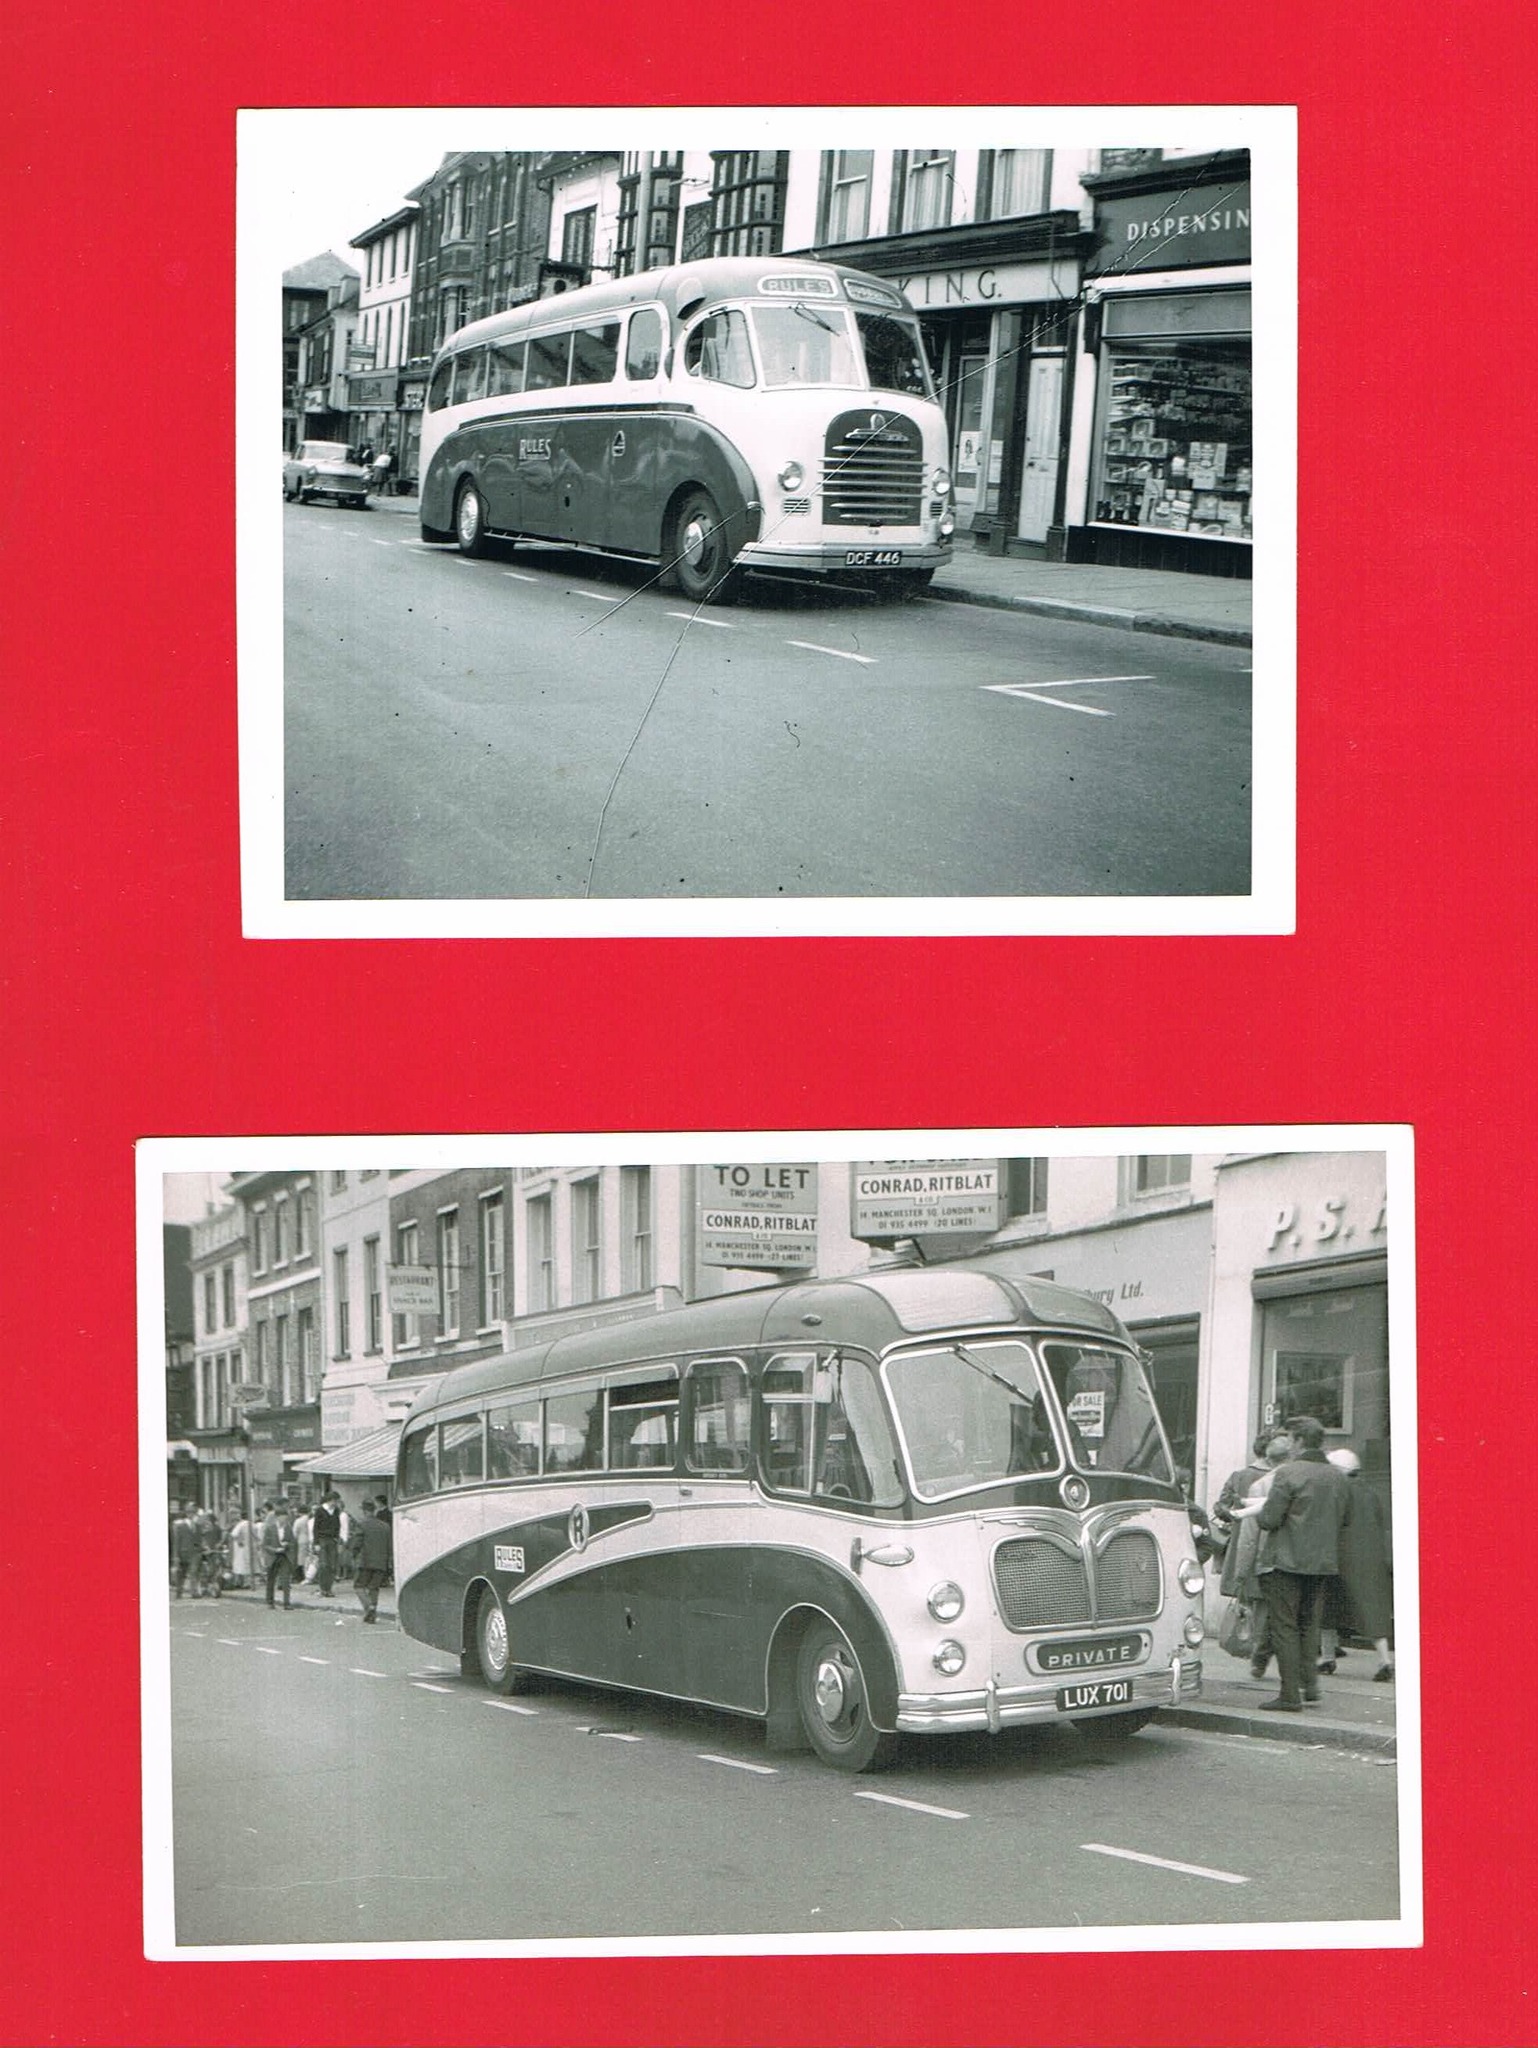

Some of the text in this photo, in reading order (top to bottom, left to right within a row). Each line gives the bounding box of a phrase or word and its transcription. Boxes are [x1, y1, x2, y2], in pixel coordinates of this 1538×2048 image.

[1127, 208, 1250, 241] DISPENSIN
[767, 280, 829, 292] RULES
[519, 438, 552, 460] RULES
[845, 551, 901, 565] DCF 446
[713, 1165, 810, 1189] TO LET
[730, 1188, 796, 1200] TWO SHOP UNITS
[871, 1208, 924, 1218] MANCHESTER
[942, 1207, 974, 1216] LONDON
[1084, 1280, 1145, 1306] ury Ltd.
[495, 1547, 523, 1570] RULES
[1047, 1645, 1131, 1668] PRIVATE
[1064, 1682, 1128, 1709] LUX 701
